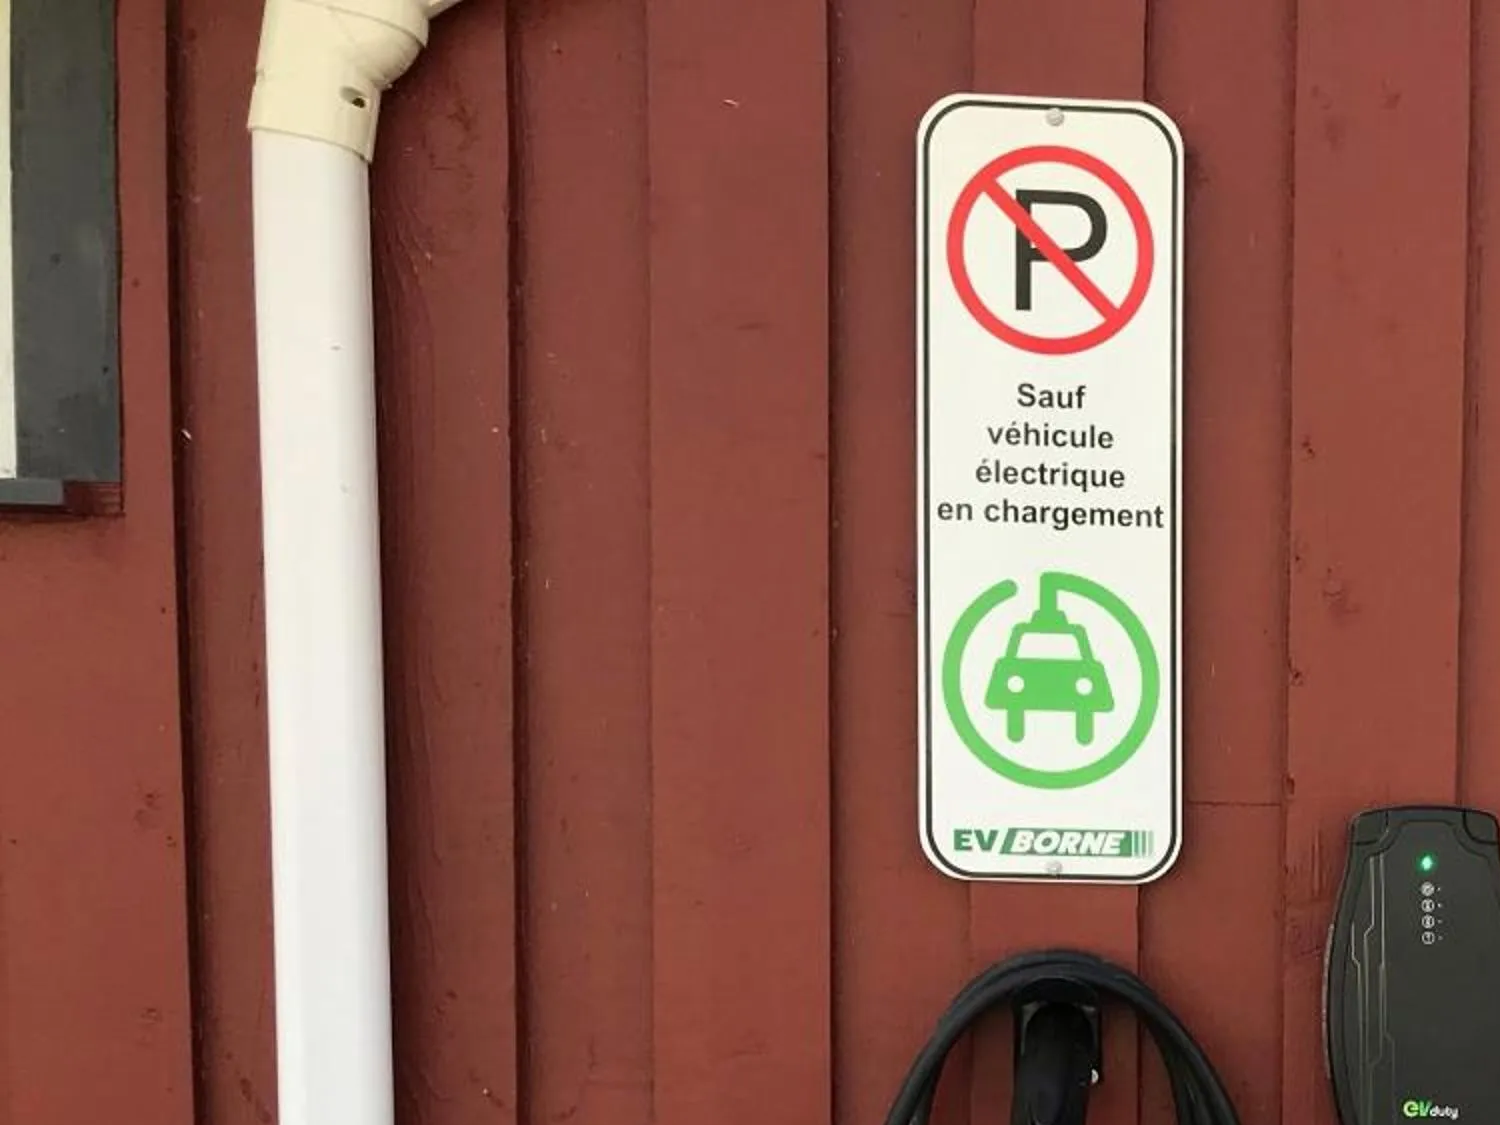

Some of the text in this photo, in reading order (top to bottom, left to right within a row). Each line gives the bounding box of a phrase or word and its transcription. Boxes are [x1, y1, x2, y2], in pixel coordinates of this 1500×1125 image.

[1014, 188, 1108, 311] P
[1016, 382, 1087, 410] Sauf
[987, 420, 1114, 450] véhicule
[975, 457, 1126, 493] électrique
[937, 499, 1165, 531] en chargement
